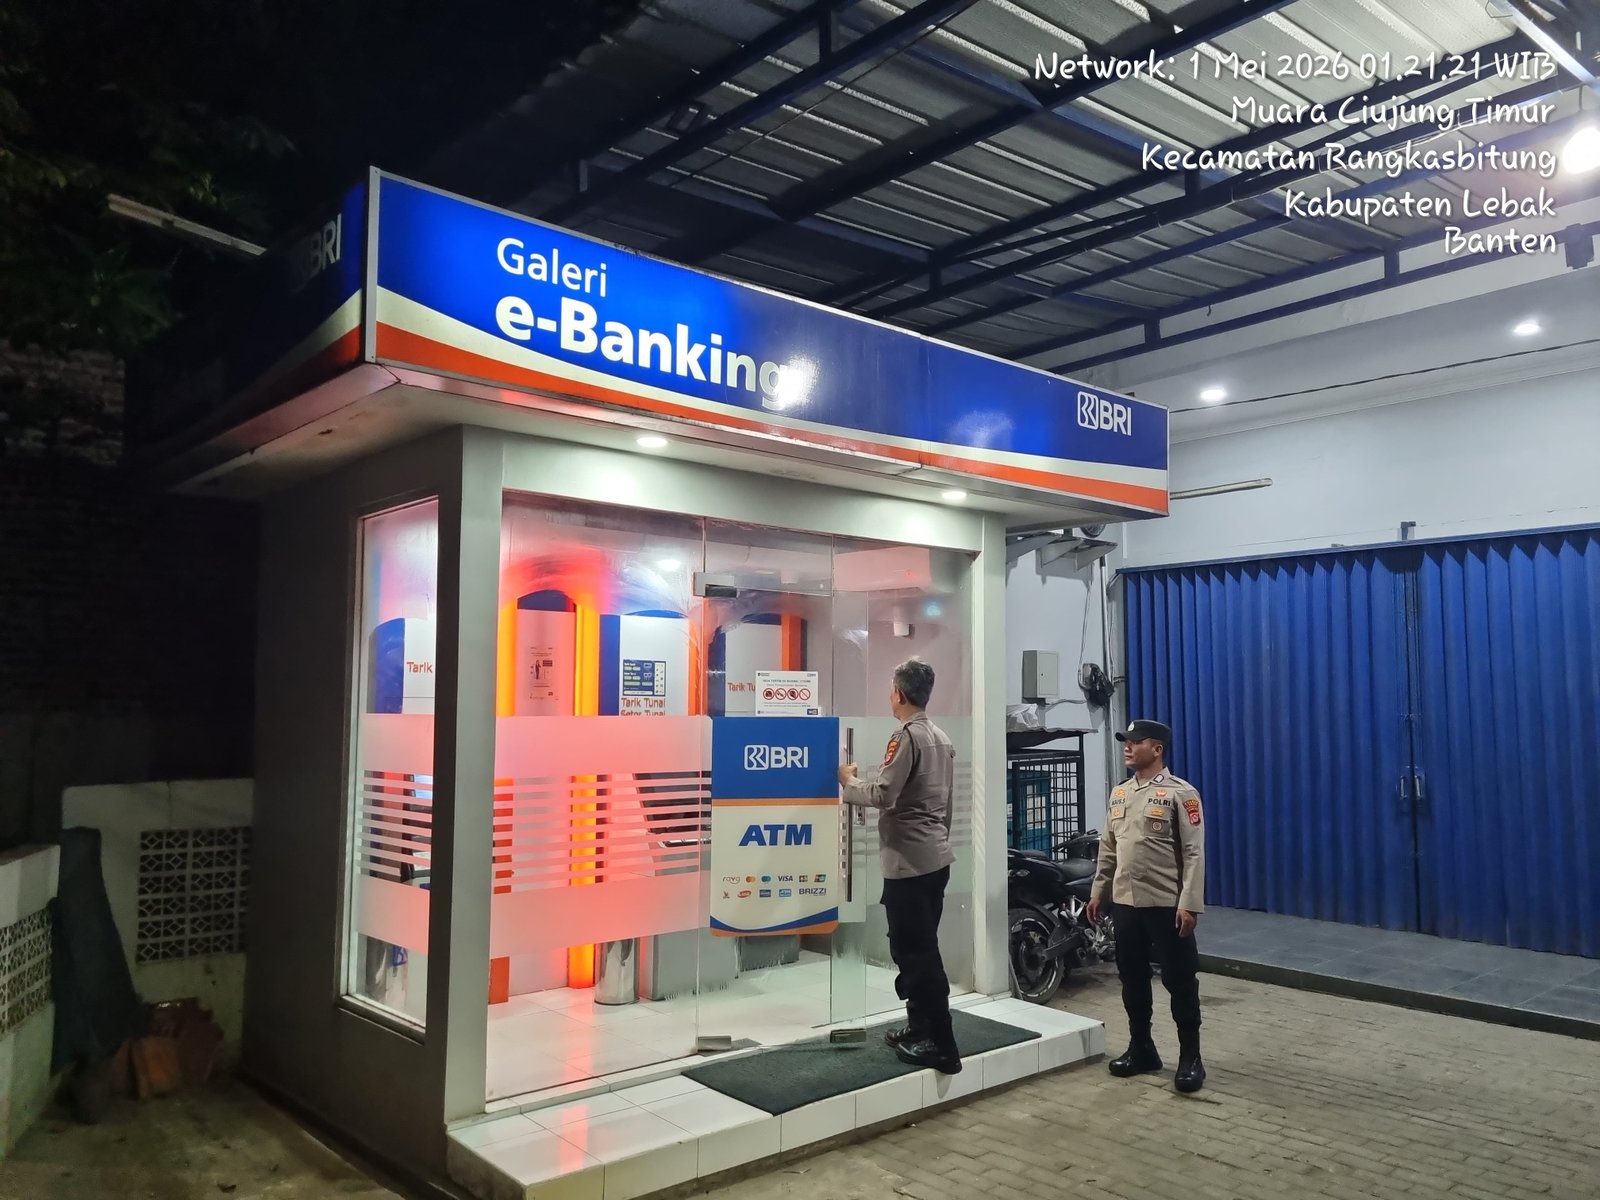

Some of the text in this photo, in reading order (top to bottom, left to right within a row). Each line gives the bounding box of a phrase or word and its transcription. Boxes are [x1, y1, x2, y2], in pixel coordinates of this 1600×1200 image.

[496, 237, 607, 297] Galeri
[495, 295, 789, 411] e-Banking
[1099, 399, 1132, 436] BRI
[406, 662, 433, 674] Tarik
[728, 682, 745, 692] Tarik
[621, 697, 666, 708] Tarik Tunai
[769, 746, 809, 769] BRI
[1147, 798, 1171, 807] POLRI
[738, 824, 813, 847] ATM
[798, 887, 827, 895] BRIZZI
